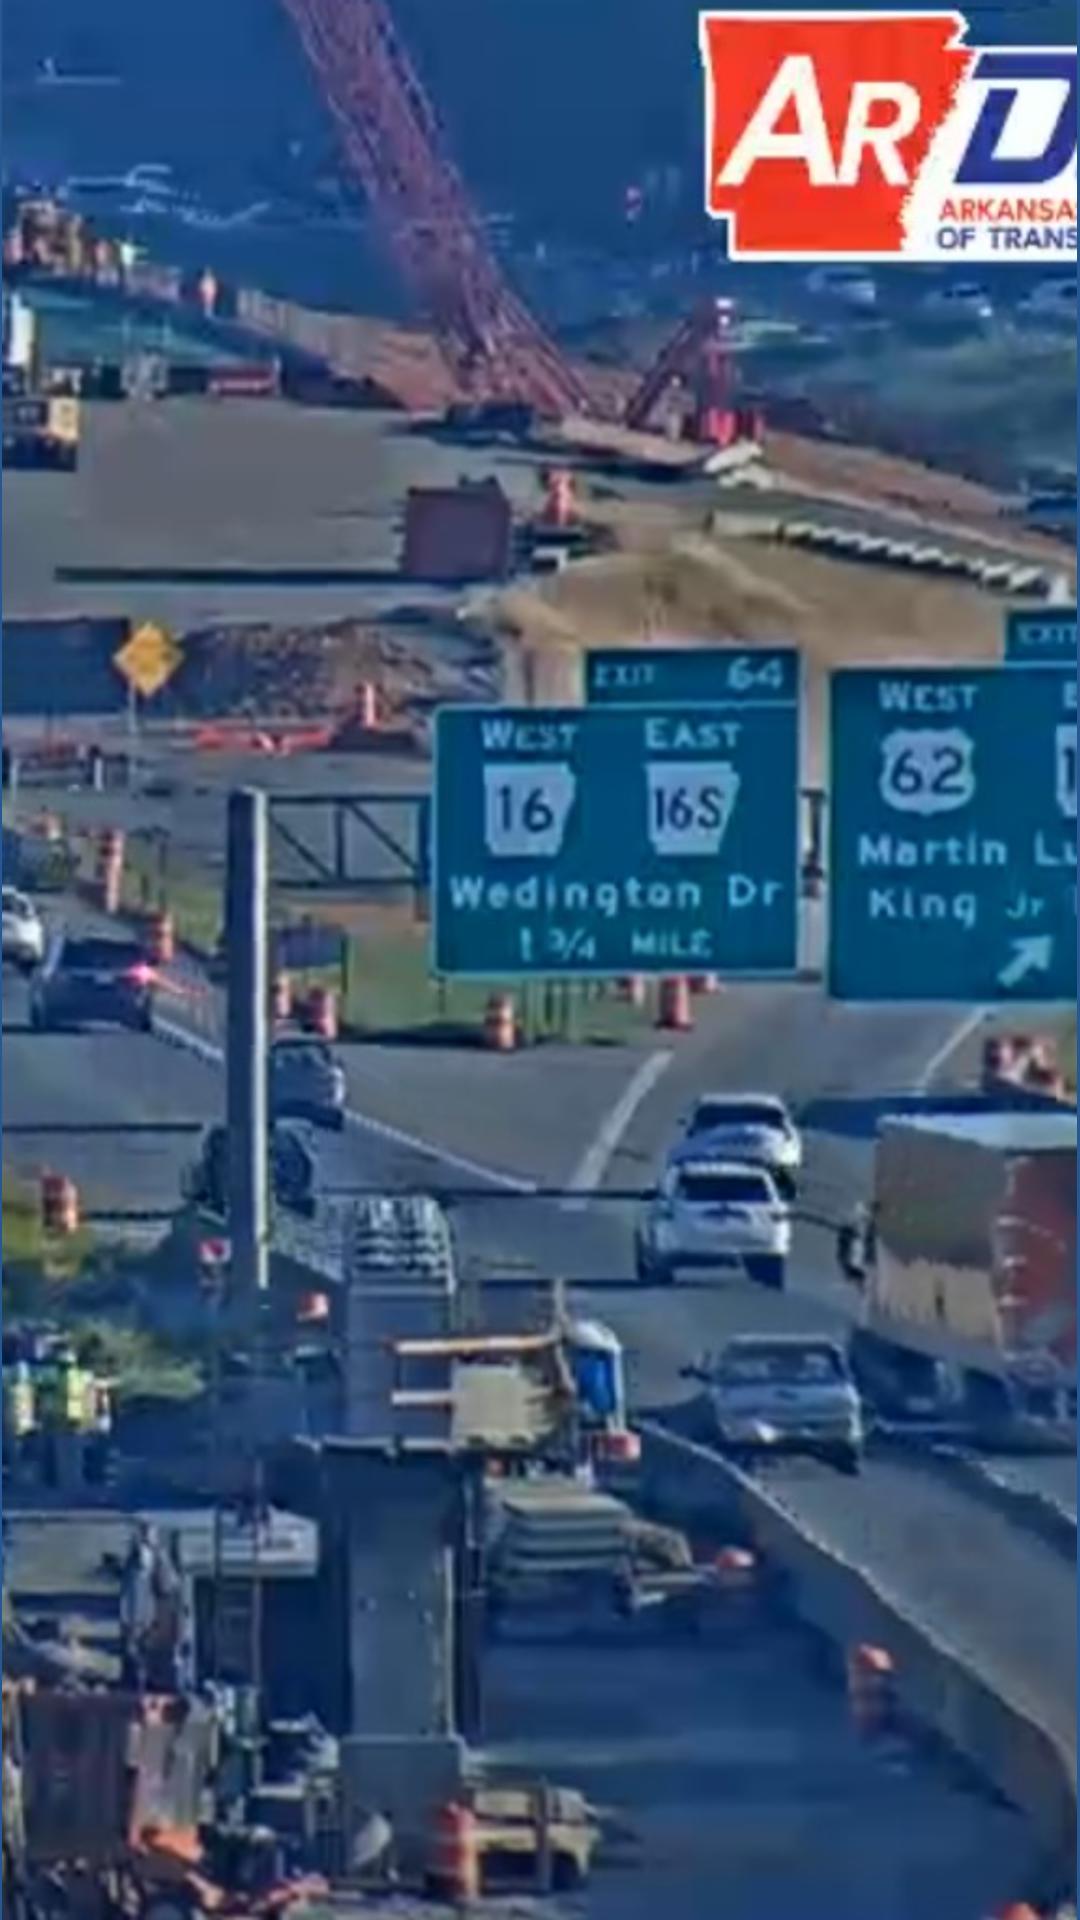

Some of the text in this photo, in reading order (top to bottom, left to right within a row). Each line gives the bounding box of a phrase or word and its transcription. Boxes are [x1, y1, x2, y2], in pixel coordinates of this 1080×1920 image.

[594, 657, 784, 689] EXIT 64
[878, 680, 978, 711] WEST
[482, 719, 578, 749] WEST
[645, 717, 742, 749] EAST
[890, 746, 967, 796] 62
[498, 785, 555, 833] 16
[858, 831, 1007, 866] Martin
[450, 874, 783, 917] Wedington Dr
[869, 887, 976, 930] King
[1005, 890, 1044, 918] Jr
[631, 931, 713, 957] MILE
